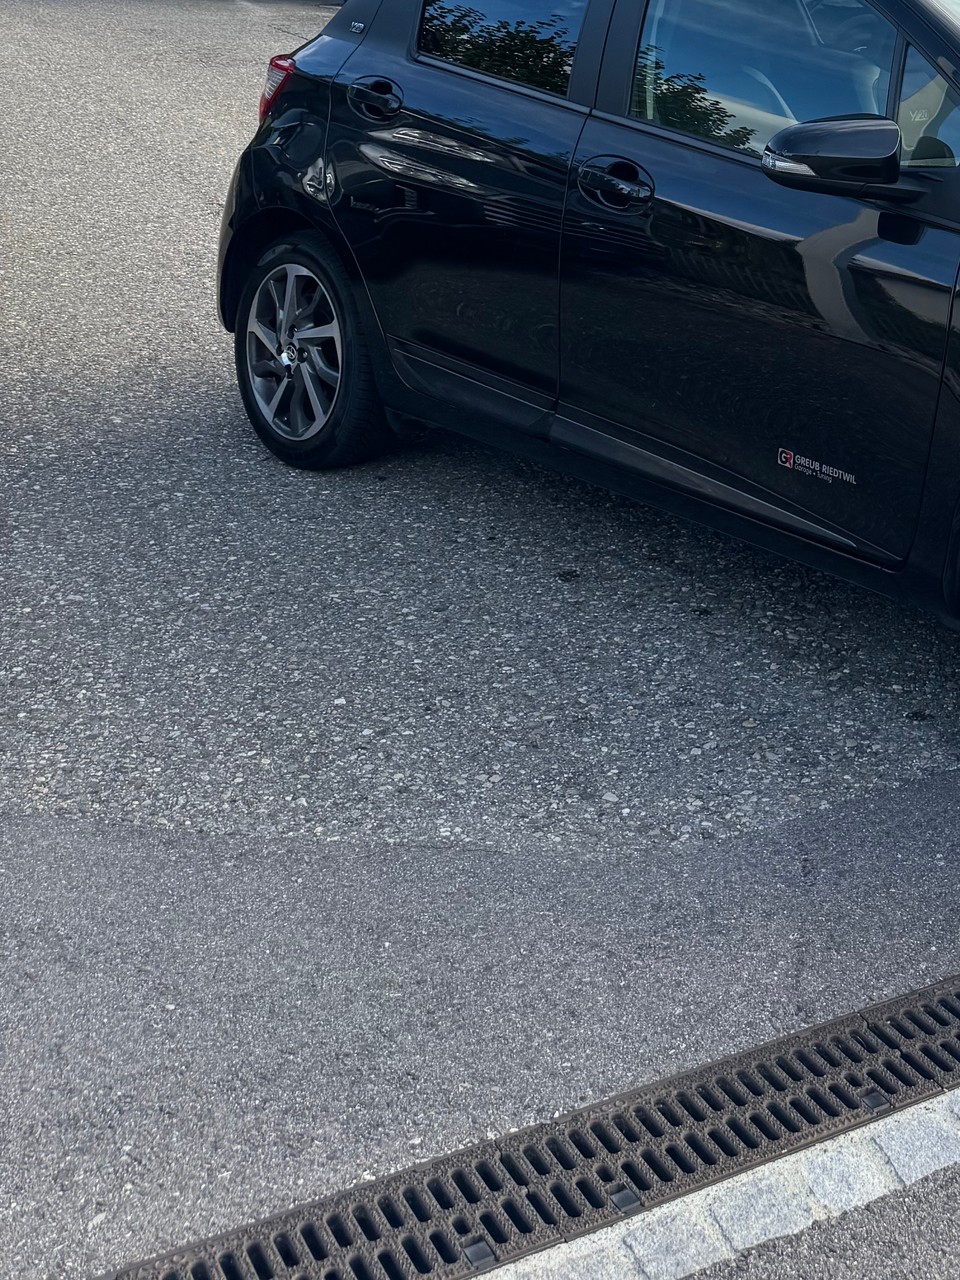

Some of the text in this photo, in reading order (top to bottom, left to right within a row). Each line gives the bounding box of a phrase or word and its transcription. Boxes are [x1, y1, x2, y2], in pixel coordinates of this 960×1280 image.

[794, 464, 812, 475] Garage
[795, 455, 820, 471] GREUB
[822, 464, 857, 484] RIEDTWIL
